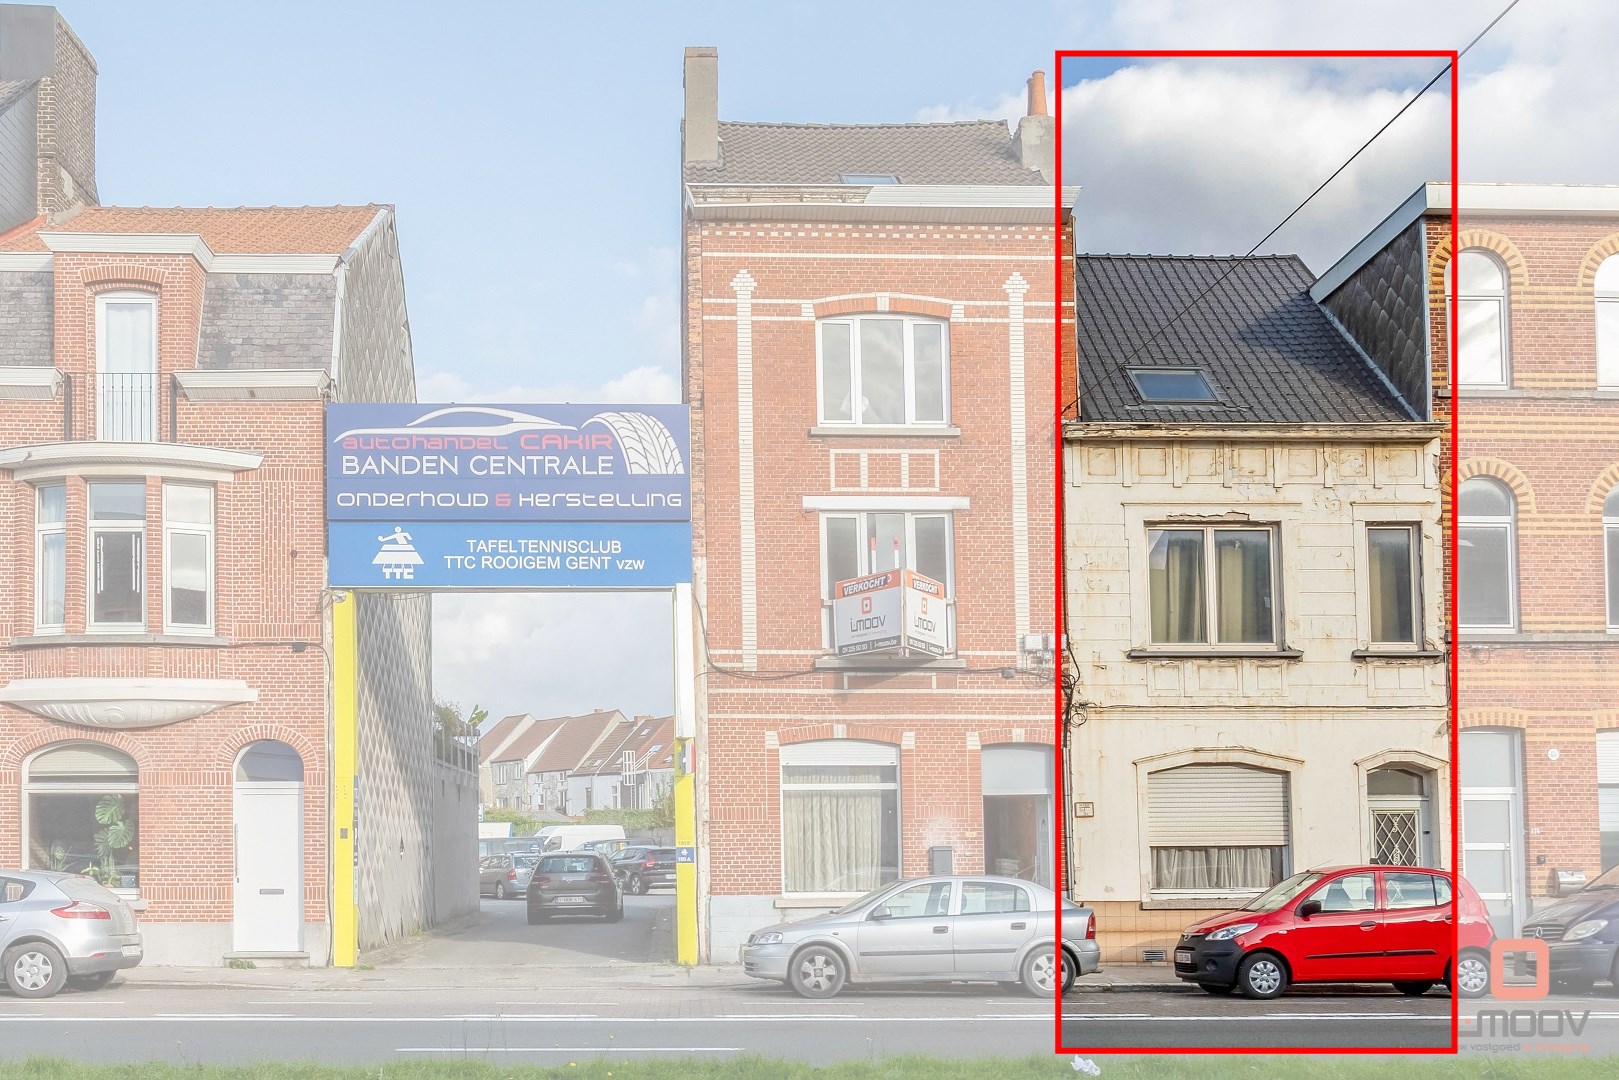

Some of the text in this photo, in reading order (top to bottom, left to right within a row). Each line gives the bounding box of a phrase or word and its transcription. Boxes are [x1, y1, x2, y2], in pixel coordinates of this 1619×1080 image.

[520, 434, 613, 450] CAKIR
[342, 455, 614, 475] BANDEN CENTRALE
[495, 493, 512, 507] &
[466, 539, 622, 553] TAFELTENNISCLUB
[444, 556, 476, 569] TTC
[481, 556, 560, 570] ROOIGEM
[565, 556, 611, 570] GENT
[383, 568, 414, 579] TTC
[843, 577, 886, 596] VERKOCHT
